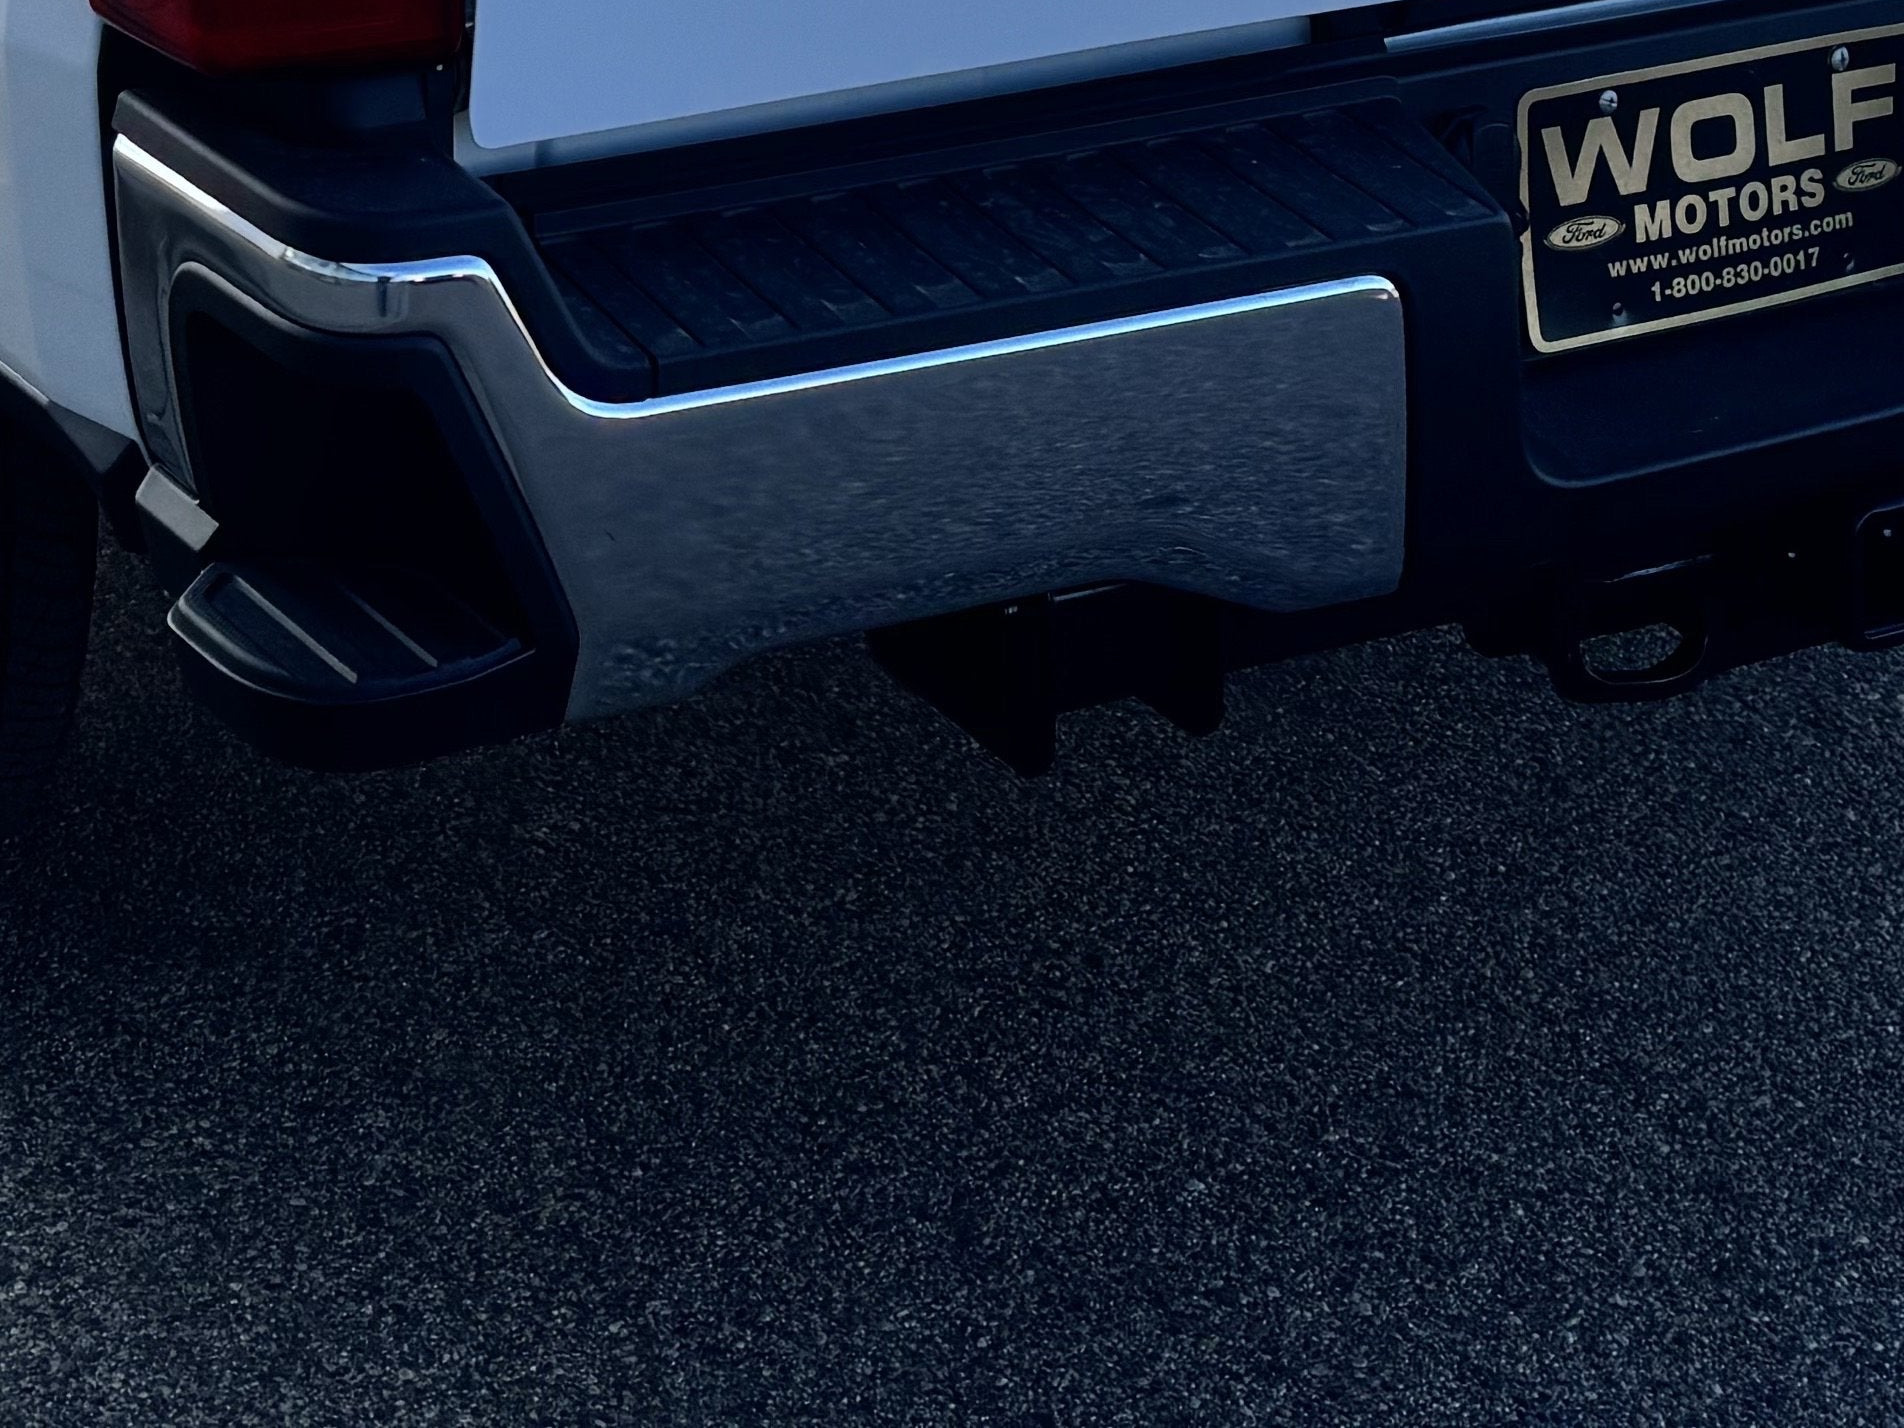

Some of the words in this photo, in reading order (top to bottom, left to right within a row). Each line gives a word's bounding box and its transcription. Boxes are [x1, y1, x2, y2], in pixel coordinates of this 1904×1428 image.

[1541, 63, 1896, 207] WOLF
[1634, 168, 1826, 244] MOTORS
[1847, 163, 1889, 190] Ford
[1561, 218, 1610, 244] Ford
[1607, 209, 1854, 279] www.wolfmotors.com
[1650, 246, 1821, 303] 1-800-830-0017
